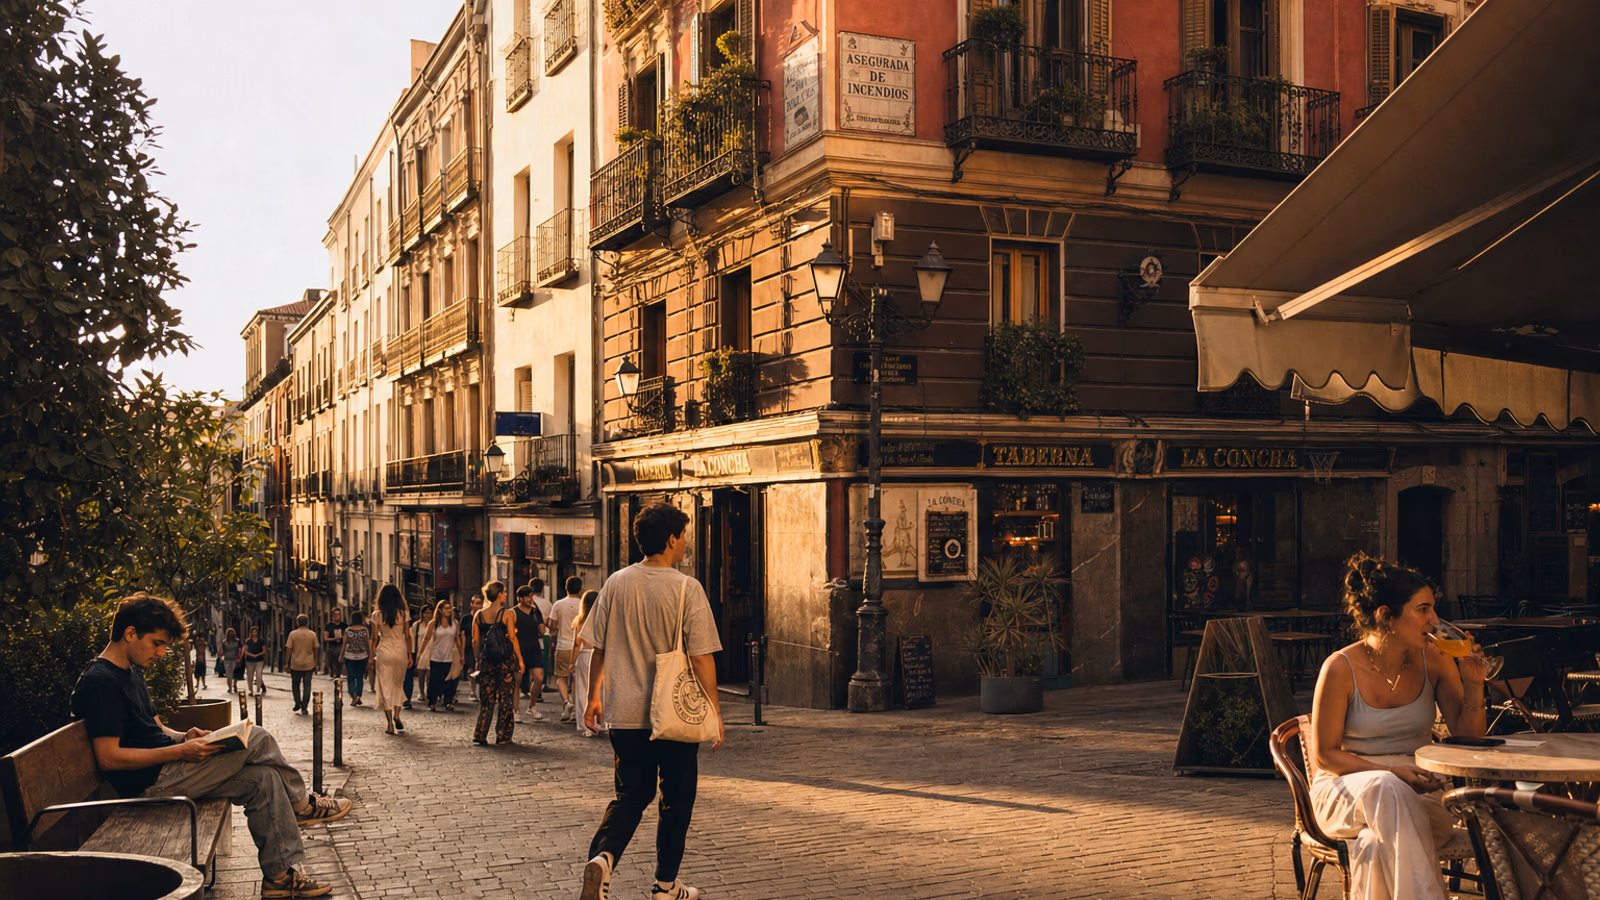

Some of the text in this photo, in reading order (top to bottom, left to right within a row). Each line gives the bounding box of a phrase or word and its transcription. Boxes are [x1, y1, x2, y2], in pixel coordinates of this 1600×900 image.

[846, 53, 910, 72] ASEGURADA
[869, 70, 886, 83] DE
[847, 82, 909, 101] INCENDIOS
[693, 452, 751, 477] LA CONCHA
[992, 446, 1094, 466] TABERNA
[1180, 448, 1298, 468] LA CONCHA
